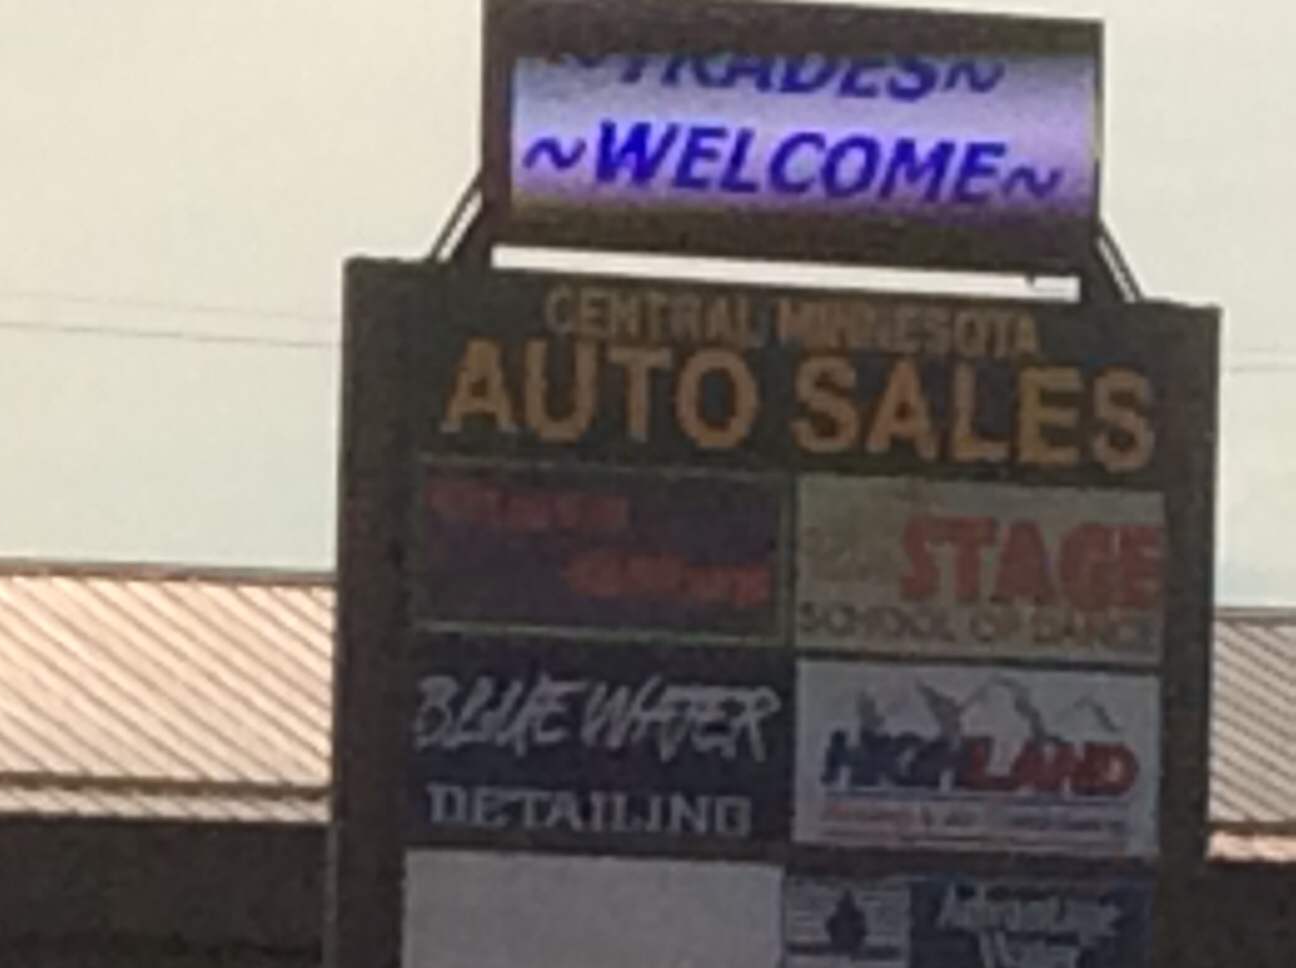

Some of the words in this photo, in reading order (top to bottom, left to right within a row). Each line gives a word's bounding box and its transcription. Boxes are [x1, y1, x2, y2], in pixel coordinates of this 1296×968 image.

[544, 287, 766, 348] CENTRAL
[774, 295, 1041, 360] MINNESOTA
[440, 336, 759, 449] AUTO
[789, 354, 1156, 473] SALES
[899, 511, 1164, 612] STAGE
[412, 671, 587, 757] BLUE
[580, 674, 782, 762] WATER
[819, 729, 1141, 797] HIGHLAND
[425, 781, 753, 838] DETAILING
